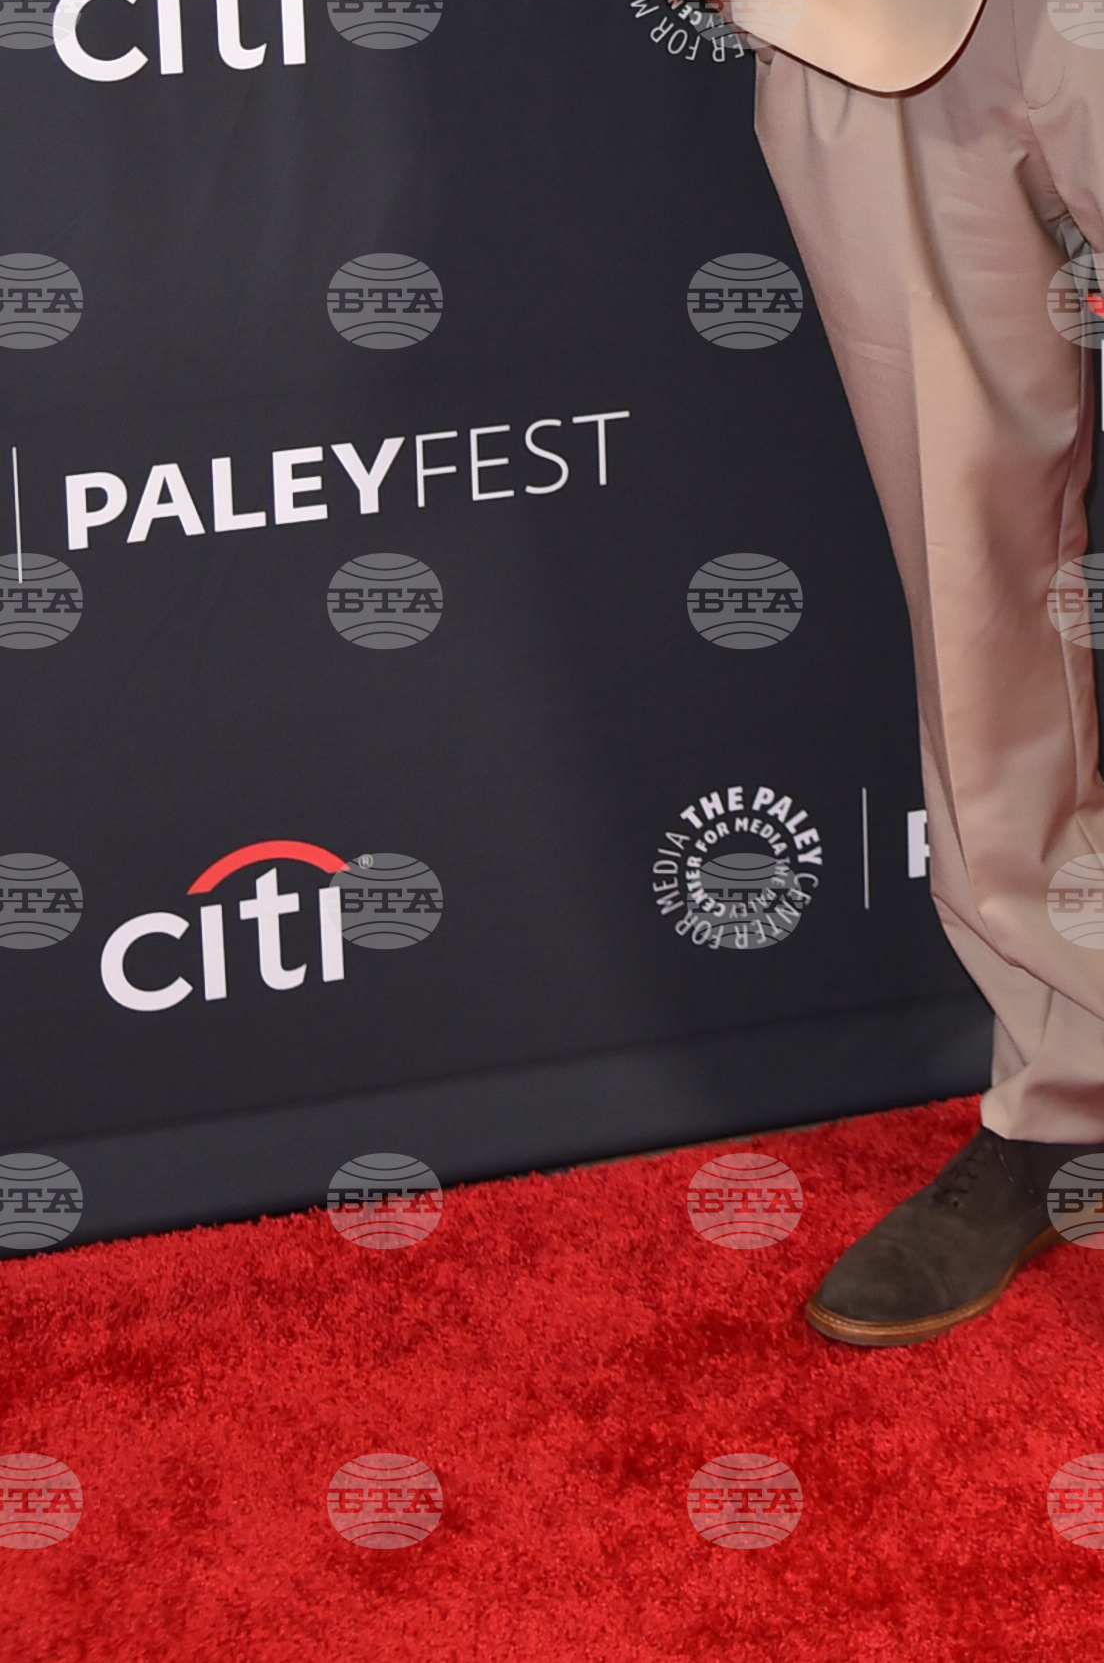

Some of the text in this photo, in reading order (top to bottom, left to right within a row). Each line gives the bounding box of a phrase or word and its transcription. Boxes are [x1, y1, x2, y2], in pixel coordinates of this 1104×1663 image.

[651, 17, 700, 60] FOR
[64, 410, 630, 551] PALEYFEST
[653, 786, 822, 949] THE PALEY CENTER FOR MEDIA
[695, 822, 730, 853] FOR
[735, 817, 787, 855] MEDIA
[100, 867, 345, 1012] citi
